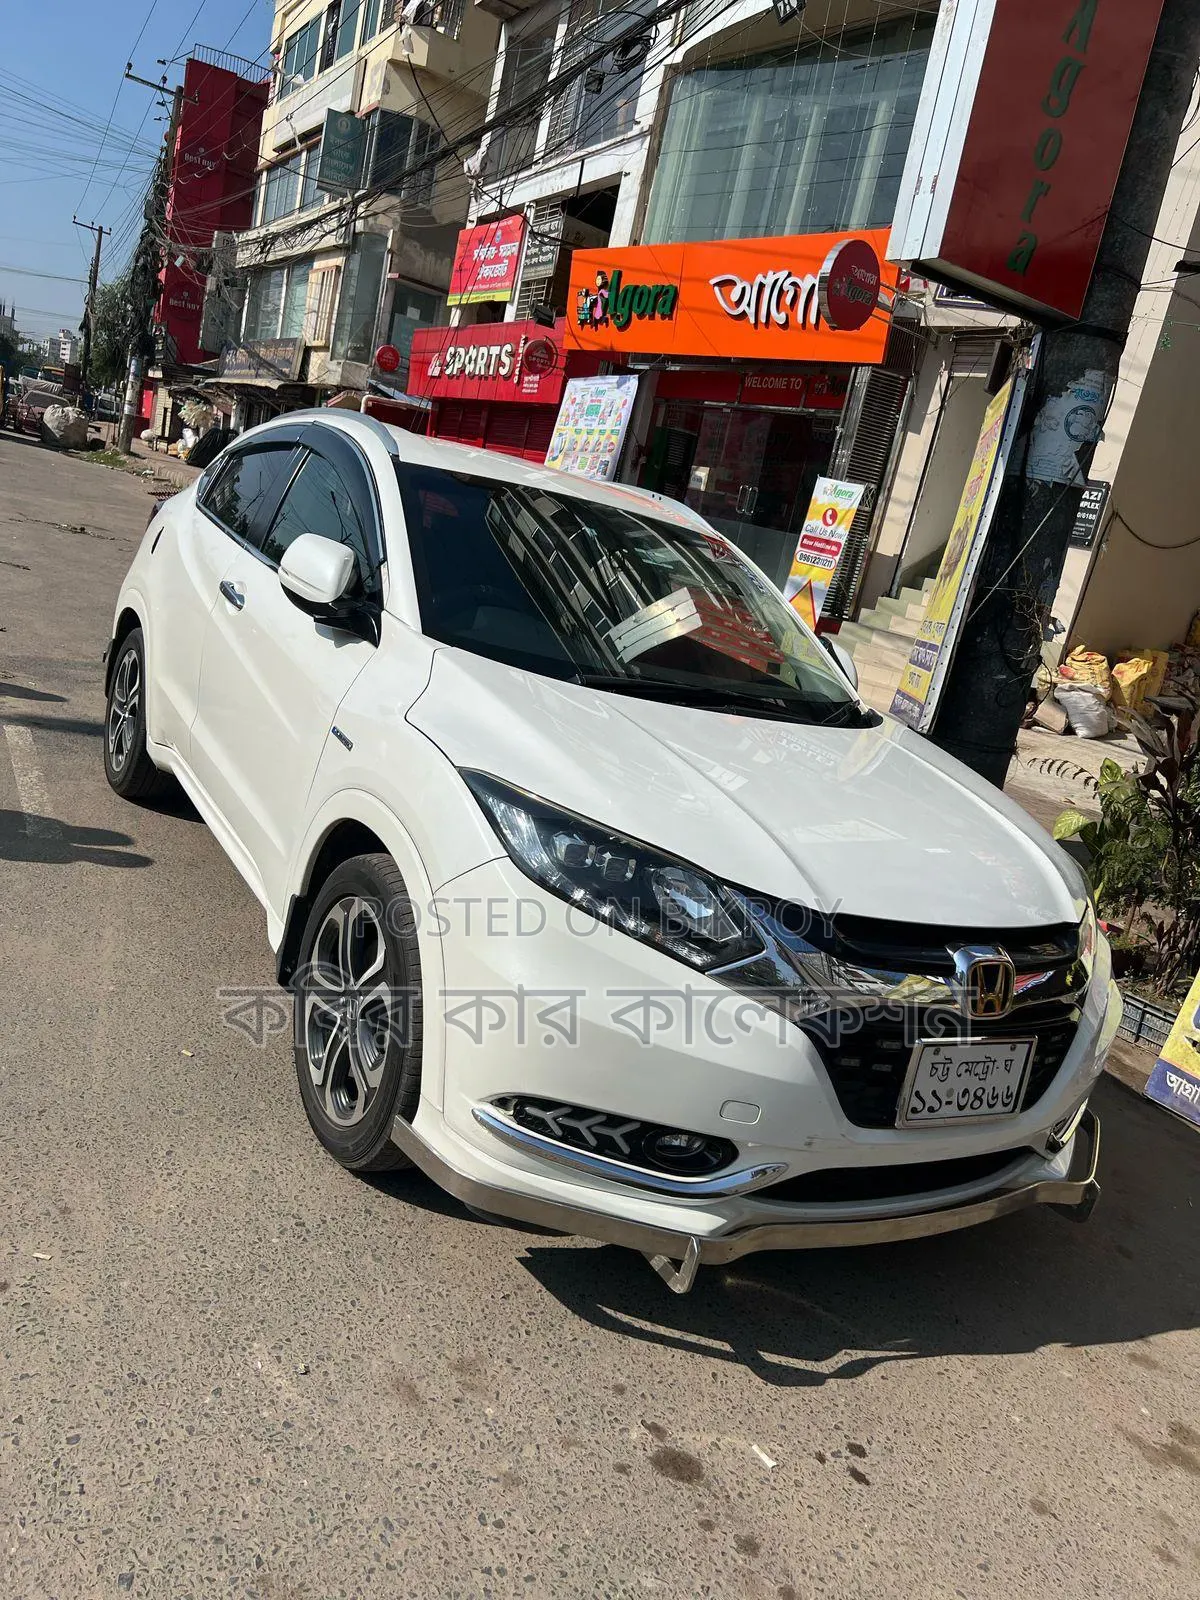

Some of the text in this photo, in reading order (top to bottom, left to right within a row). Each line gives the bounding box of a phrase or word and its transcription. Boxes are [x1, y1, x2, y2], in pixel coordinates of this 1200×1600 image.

[606, 270, 678, 326] Agora
[444, 343, 512, 377] SPORTS
[744, 376, 787, 389] WELCOME
[789, 377, 802, 390] TO
[832, 484, 854, 499] Agora
[804, 524, 818, 536] Call
[819, 527, 829, 537] Us
[910, 1085, 1014, 1114] ১১-৩৪৬৬
